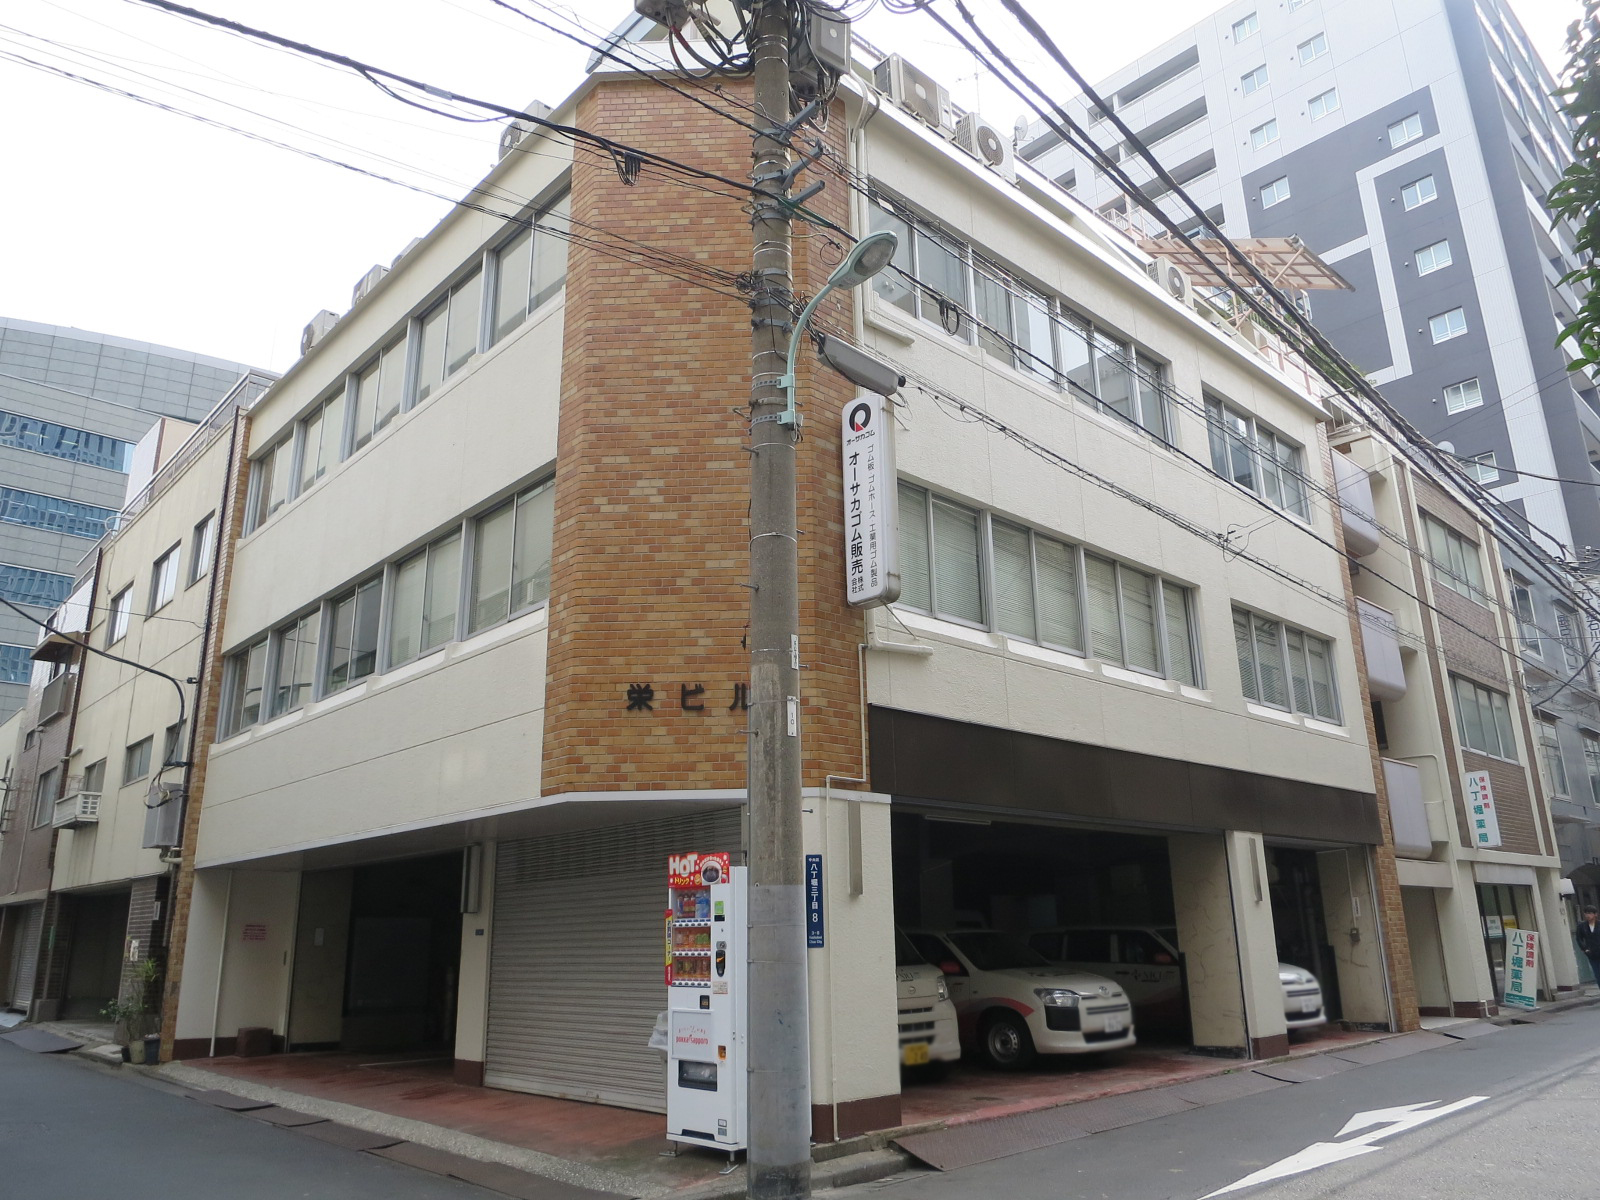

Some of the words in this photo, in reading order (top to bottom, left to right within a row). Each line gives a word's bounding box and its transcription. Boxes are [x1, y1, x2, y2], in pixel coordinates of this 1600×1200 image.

[1469, 777, 1488, 843] 八丁堀薬局
[669, 853, 698, 877] HOT
[810, 863, 819, 910] 八丁堀三丁目
[812, 912, 819, 923] 8
[1510, 931, 1524, 994] 八丁堀薬局
